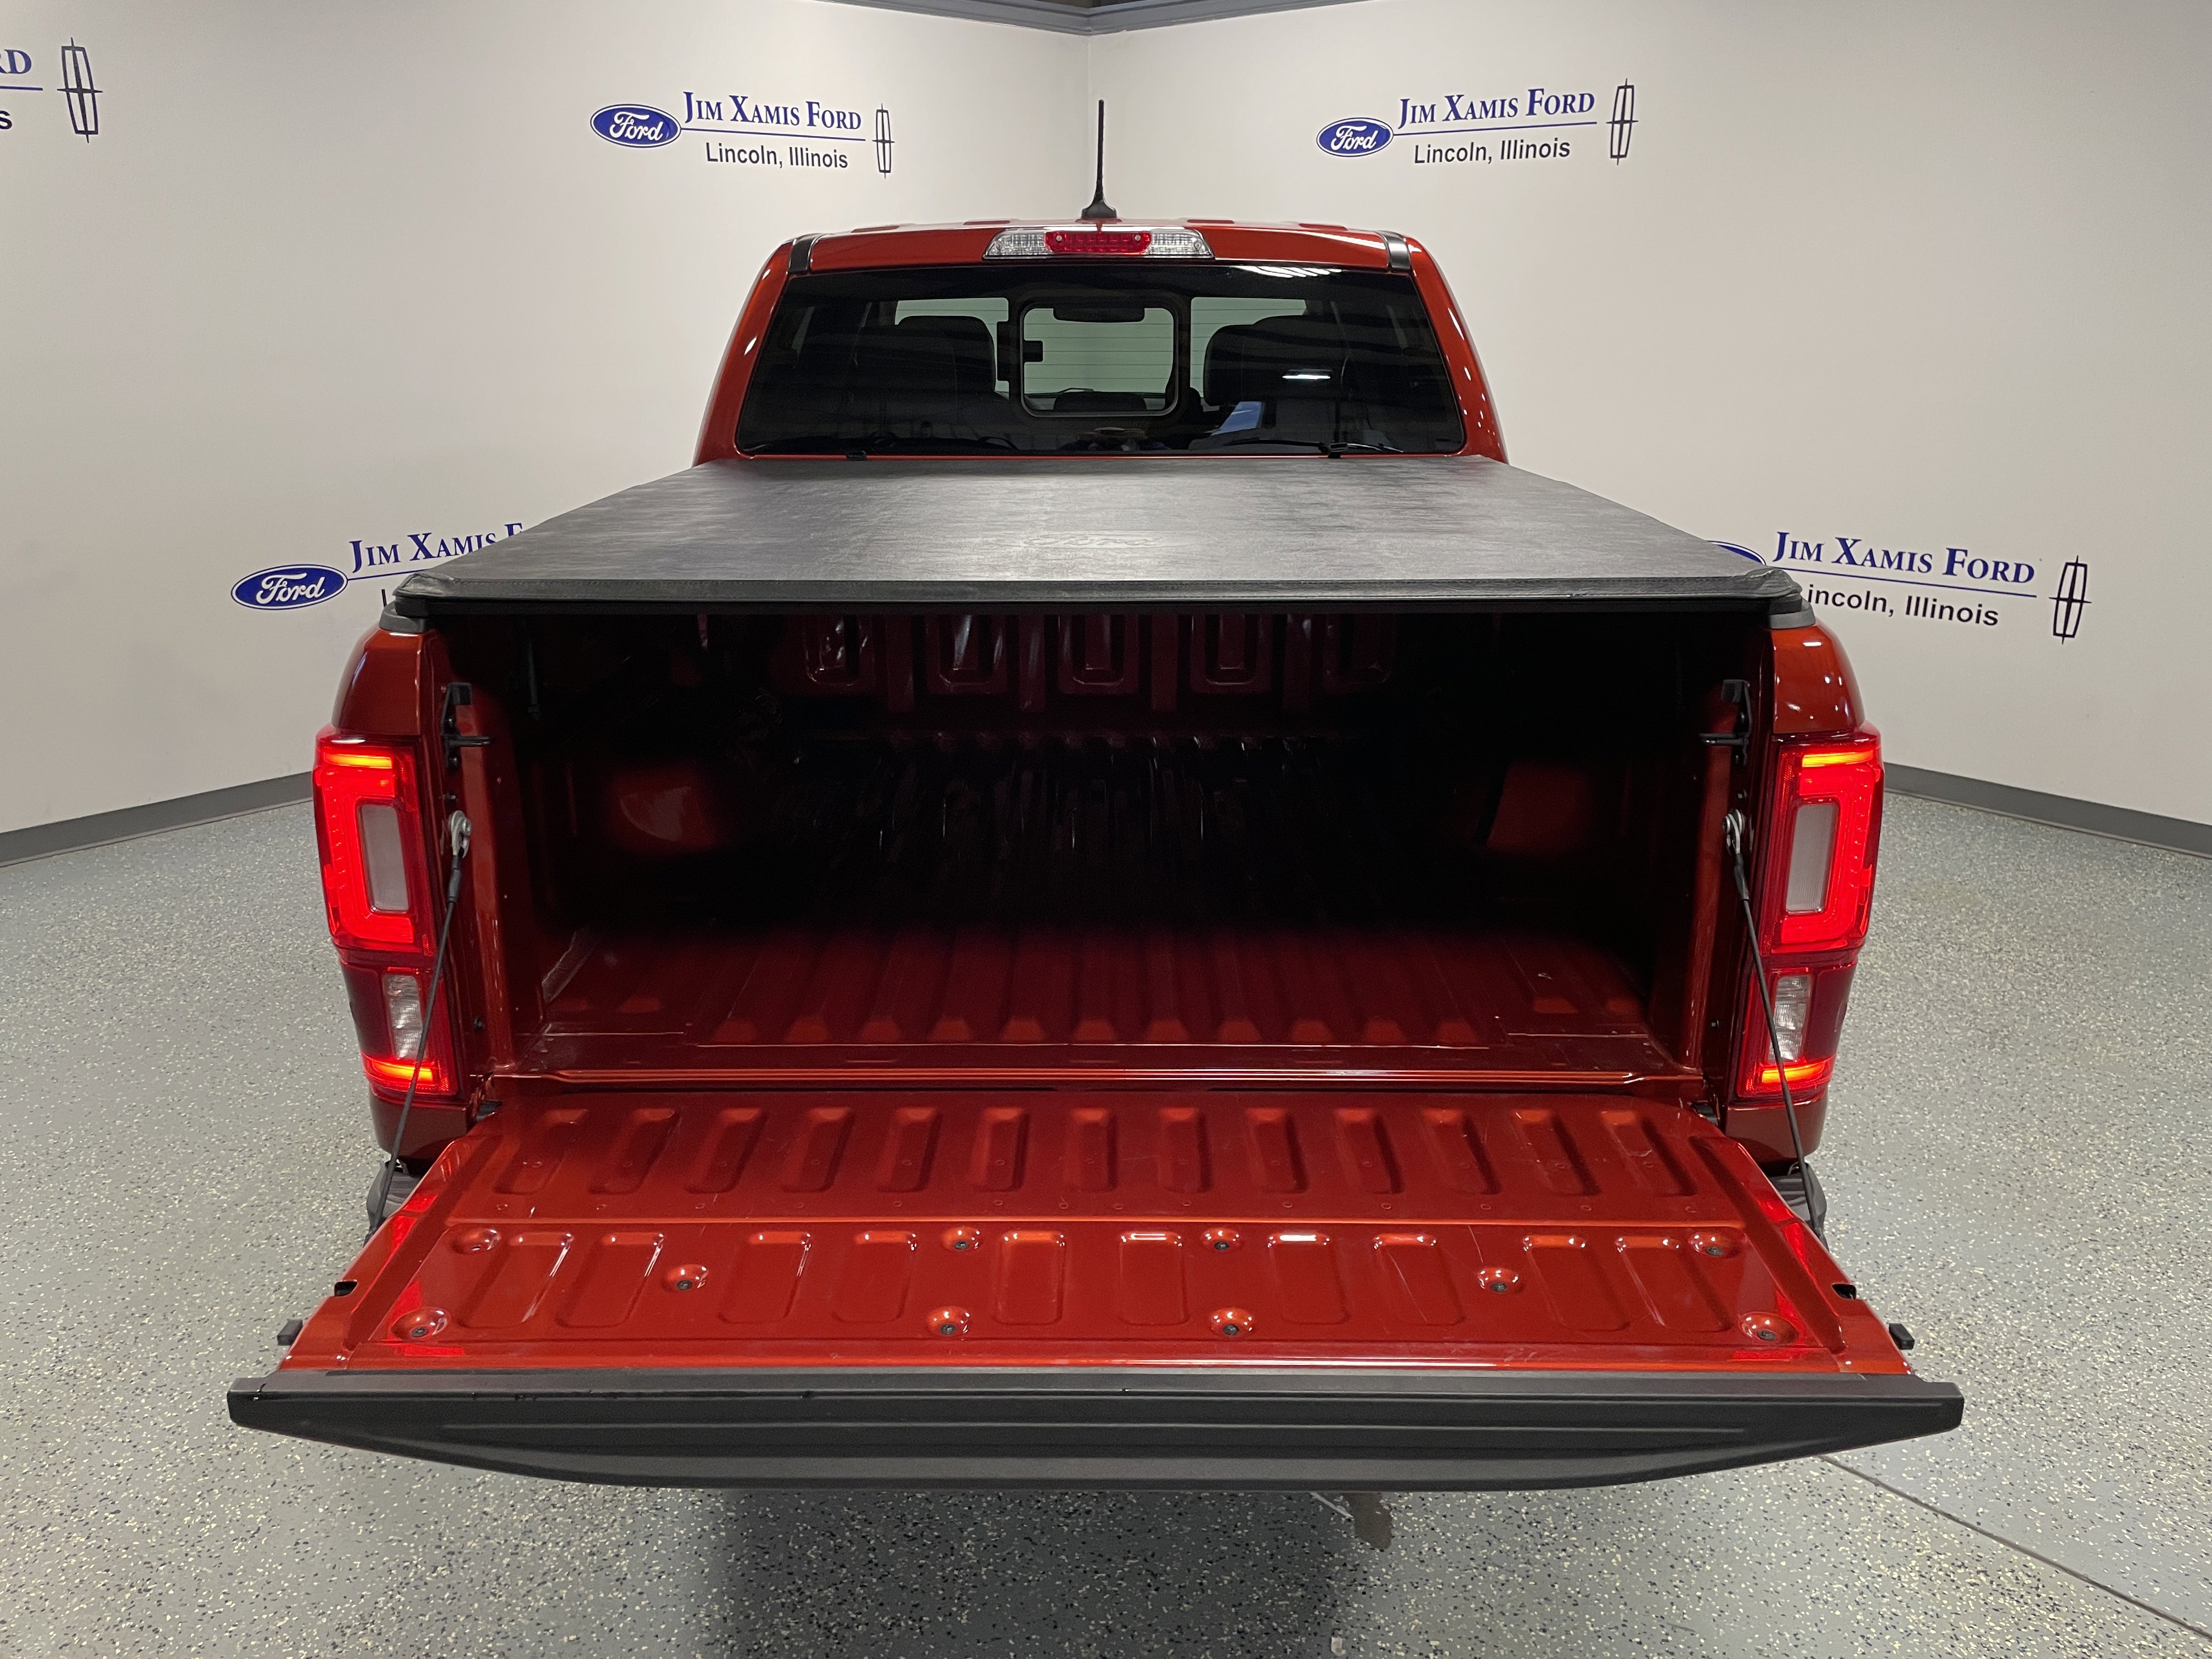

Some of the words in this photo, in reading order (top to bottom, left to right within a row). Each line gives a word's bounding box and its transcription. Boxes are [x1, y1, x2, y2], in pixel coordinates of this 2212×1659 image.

[683, 91, 724, 123] JIM
[729, 95, 800, 126] XAMIS
[805, 101, 861, 129] FORD
[1398, 98, 1436, 129] JIM
[1442, 94, 1518, 122] XAMIS
[1525, 88, 1595, 116] FORD
[610, 111, 663, 140] Ford
[1330, 125, 1378, 150] Ford
[706, 142, 782, 169] Lincoln,
[789, 146, 849, 168] Illinois
[1414, 142, 1492, 165] Lincoln,
[1500, 137, 1570, 160] Illinois
[348, 540, 401, 574] JIM
[1772, 531, 1824, 562] JIM
[1832, 537, 1933, 573] XAMIS
[1942, 547, 2035, 583] FORD
[256, 572, 325, 604] Ford
[1808, 584, 1894, 618] incoln,
[1905, 595, 1999, 626] Illinois
